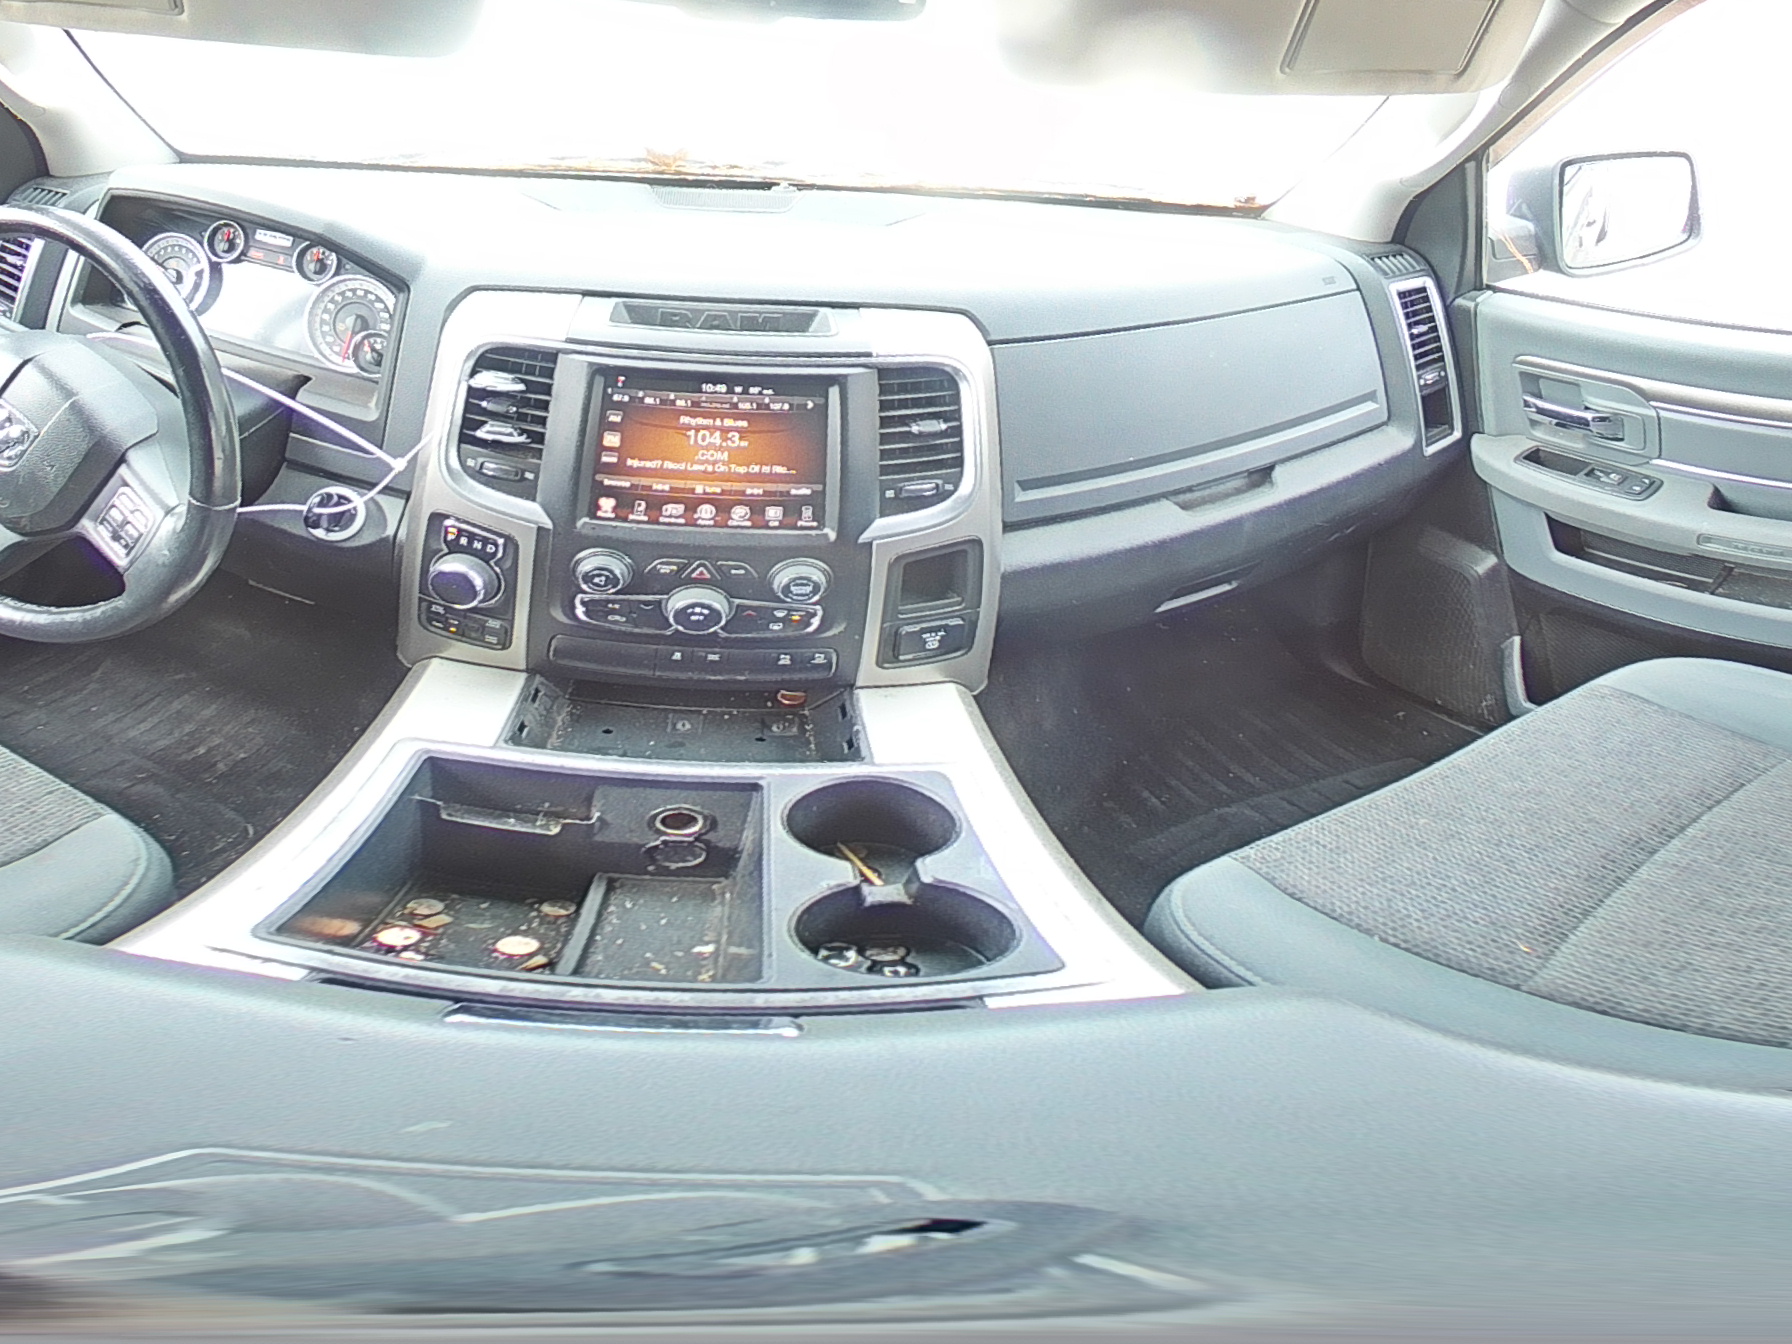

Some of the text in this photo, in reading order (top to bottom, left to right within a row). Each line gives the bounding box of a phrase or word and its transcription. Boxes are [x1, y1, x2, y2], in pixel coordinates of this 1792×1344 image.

[659, 308, 784, 333] RAM
[686, 429, 740, 448] 104.3
[695, 449, 729, 461] .COM
[729, 464, 748, 474] Top
[459, 536, 469, 546] R
[486, 543, 496, 553] D
